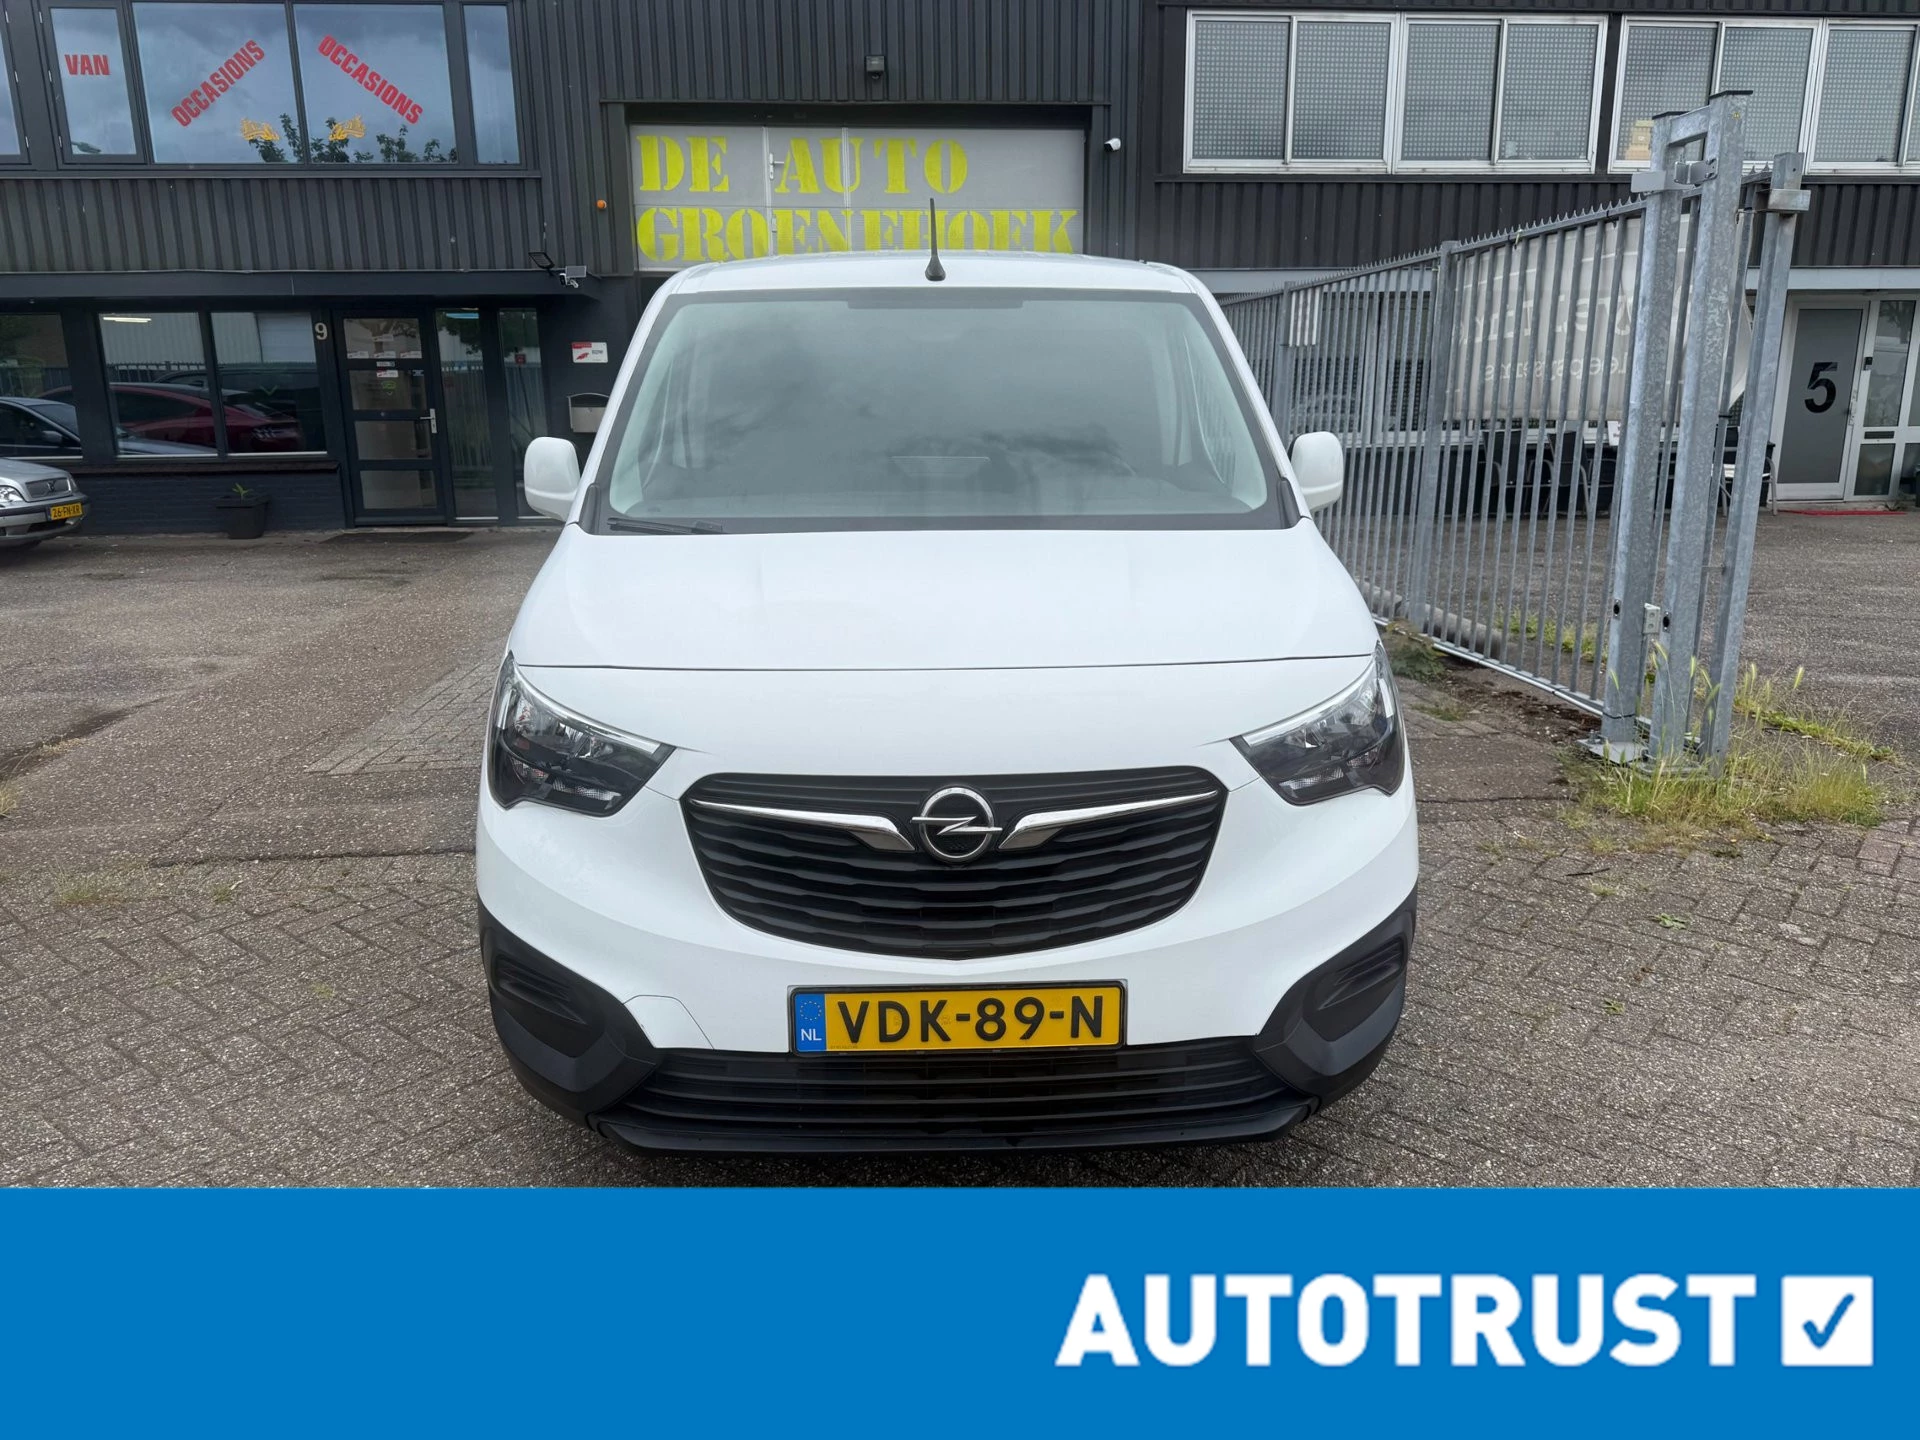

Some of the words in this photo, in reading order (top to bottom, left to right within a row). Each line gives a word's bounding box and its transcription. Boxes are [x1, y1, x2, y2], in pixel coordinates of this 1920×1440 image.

[65, 55, 109, 75] VAN
[171, 40, 265, 127] OCCASIONS
[318, 35, 423, 124] OCCASIONS
[637, 135, 729, 192] DE
[776, 137, 968, 193] AUTO
[314, 322, 328, 341] 9
[1804, 361, 1838, 414] 5
[801, 1028, 822, 1042] NL
[838, 995, 1103, 1044] VDK-89-N
